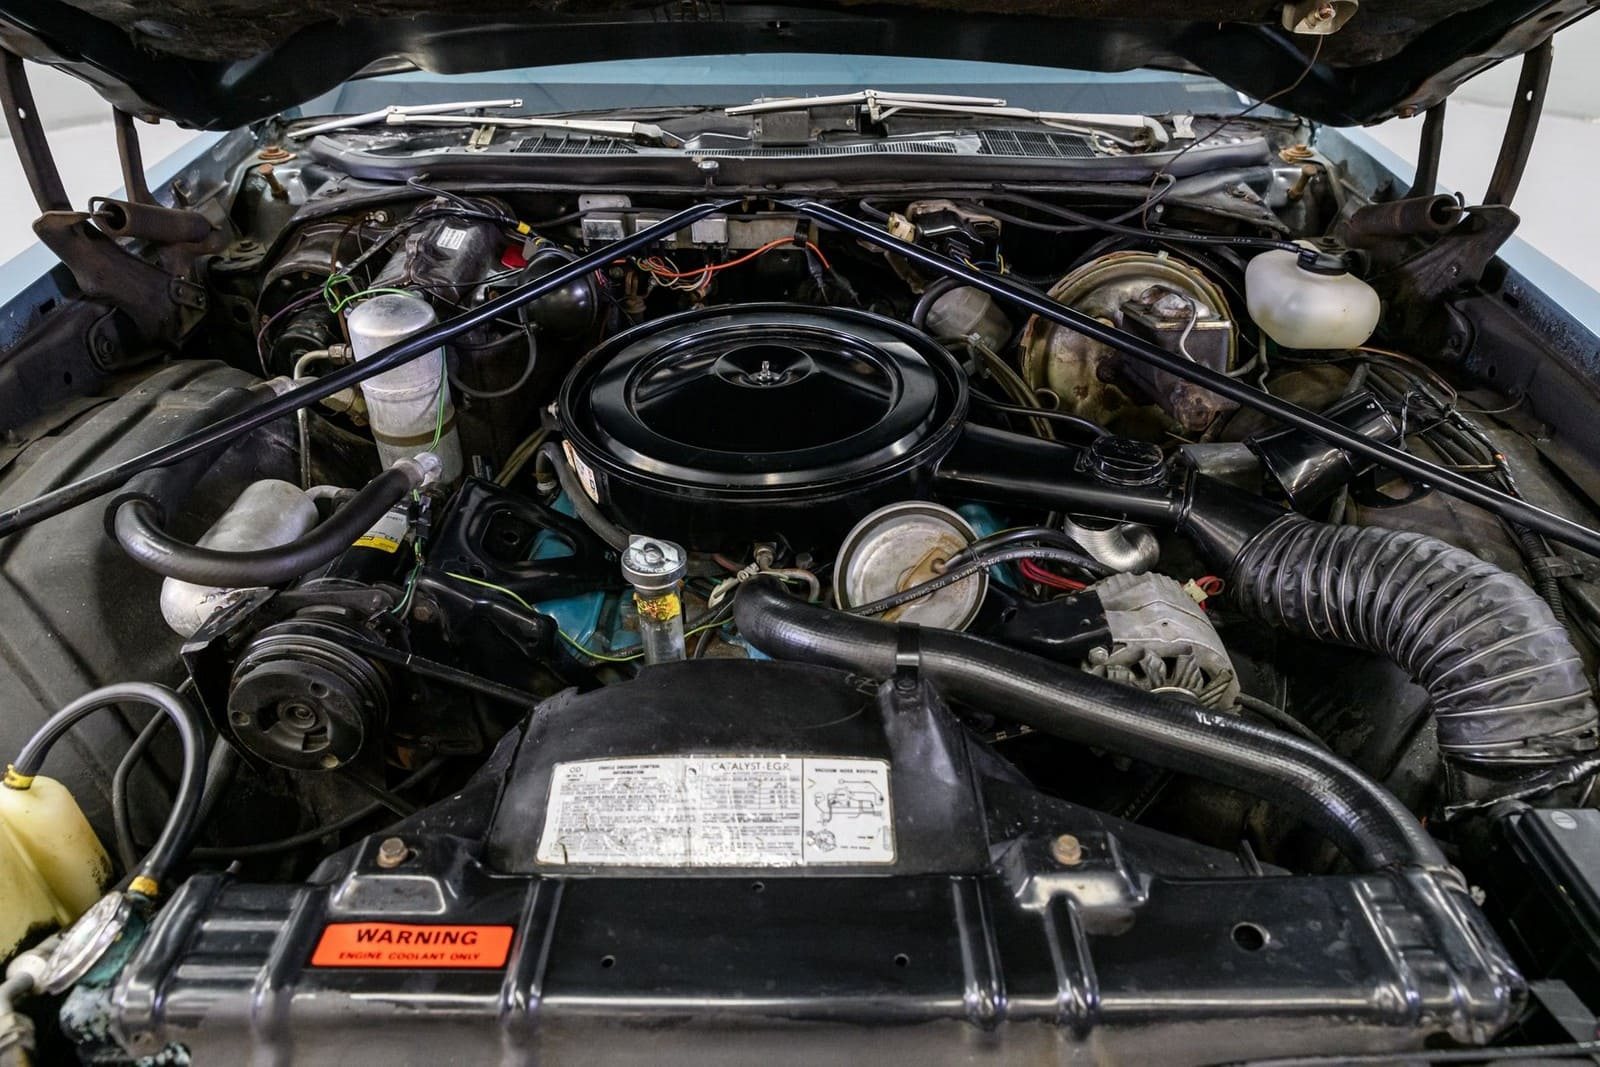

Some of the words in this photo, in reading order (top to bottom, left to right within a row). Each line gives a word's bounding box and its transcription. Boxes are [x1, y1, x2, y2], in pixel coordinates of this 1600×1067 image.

[356, 928, 479, 945] WARNING
[338, 951, 383, 960] ENGINE
[388, 951, 446, 960] COOLANT
[449, 951, 481, 961] ONLY
